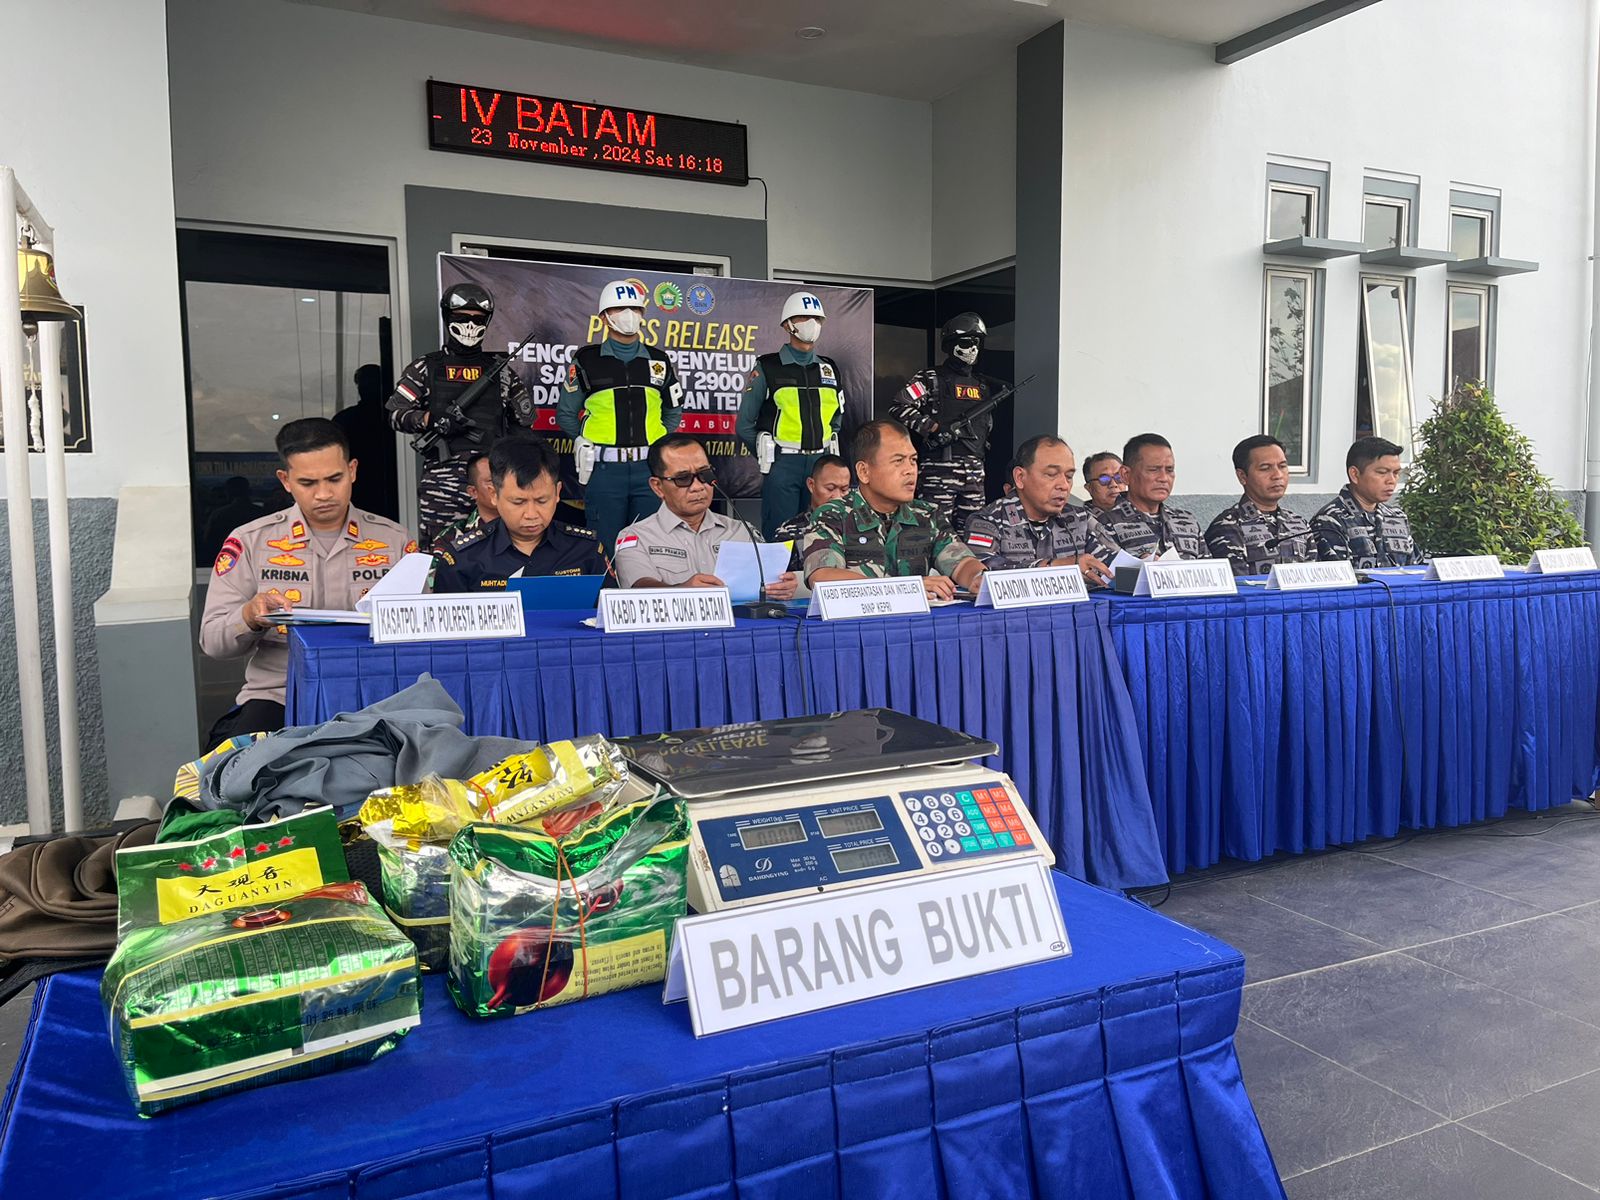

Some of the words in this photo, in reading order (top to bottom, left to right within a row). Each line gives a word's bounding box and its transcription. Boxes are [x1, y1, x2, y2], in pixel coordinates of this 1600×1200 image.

[460, 88, 500, 126] IV
[516, 96, 656, 147] BATAM
[471, 128, 492, 145] 23
[507, 132, 588, 158] November
[645, 150, 673, 168] Sat
[678, 154, 722, 173] 16:18
[615, 286, 637, 300] PM
[802, 297, 821, 310] PM
[587, 315, 660, 348] PSS
[664, 320, 759, 352] RELEASE
[540, 364, 566, 385] SA
[694, 372, 745, 391] 2900
[533, 385, 560, 405] DA
[681, 392, 711, 410] AN
[261, 569, 309, 581] KRISNA
[1153, 567, 1218, 590] DANLANTAMAL
[1218, 567, 1228, 587] IV
[822, 588, 839, 600] KABID
[840, 585, 882, 599] PEMBERANTASAN
[882, 584, 896, 596] DAN
[993, 578, 1030, 600] DANDIM
[1031, 575, 1081, 597] 0316/BATAM
[610, 600, 636, 625] KABID
[639, 599, 651, 623] P2
[652, 598, 670, 623] BEA
[672, 598, 698, 622] CUKAI
[698, 597, 726, 621] BATAM
[861, 603, 876, 614] BNNP
[877, 601, 892, 613] KEPRI
[380, 606, 420, 635] KASATPOL
[423, 605, 436, 632] AIR
[437, 604, 476, 633] POLRESTA
[478, 603, 517, 631] BARELANG
[961, 793, 970, 802] C
[976, 791, 988, 801] M1
[830, 807, 842, 815] UNIT
[842, 805, 859, 813] PRICE
[983, 805, 996, 815] M3
[1000, 803, 1012, 812] M4
[752, 815, 784, 825] WEIGHT(kg)
[843, 840, 858, 848] TOTAL
[858, 838, 874, 846] PRICE
[1015, 832, 1027, 842] M7
[189, 879, 293, 914] DAGUANYIN
[709, 908, 903, 1011] BARANG
[918, 883, 1043, 965] BUKTI
